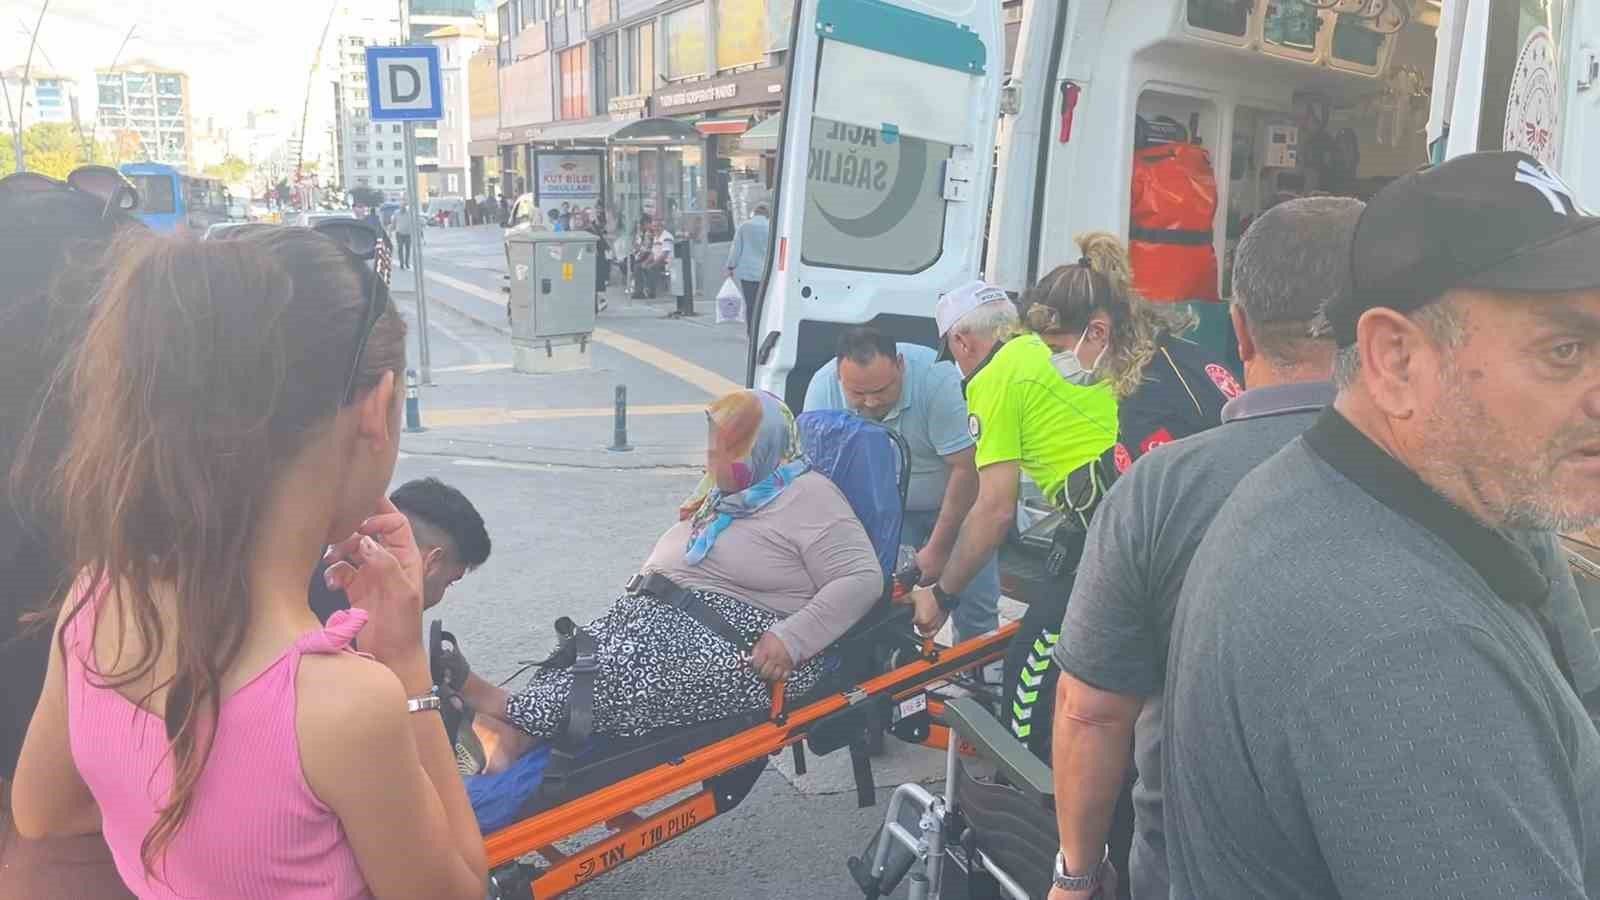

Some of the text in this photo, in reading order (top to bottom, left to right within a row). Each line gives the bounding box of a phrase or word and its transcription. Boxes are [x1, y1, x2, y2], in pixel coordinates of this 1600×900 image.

[388, 64, 421, 103] D
[600, 842, 626, 869] TAY
[668, 808, 696, 839] PLUS
